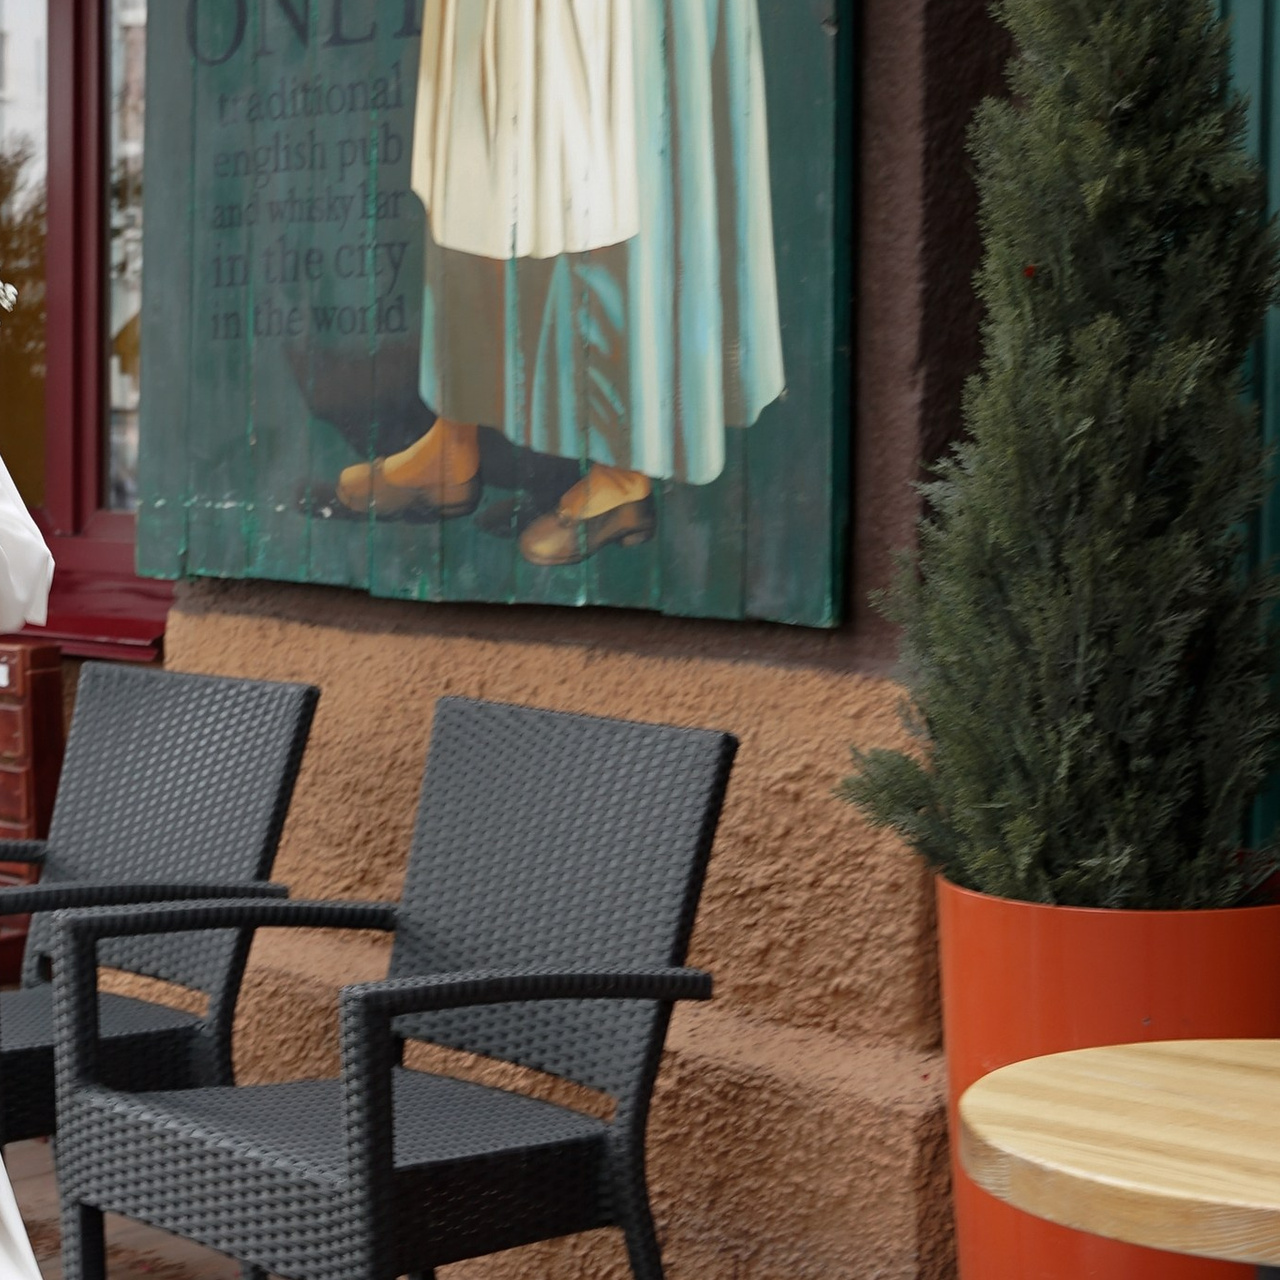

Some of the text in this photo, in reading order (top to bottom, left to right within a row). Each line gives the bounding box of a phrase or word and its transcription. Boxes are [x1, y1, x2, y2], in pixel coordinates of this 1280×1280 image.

[217, 61, 404, 123] traditional
[214, 122, 404, 189] english pub
[213, 181, 407, 232] and whisky bar
[212, 230, 410, 296] in the city
[211, 293, 409, 341] in the world
